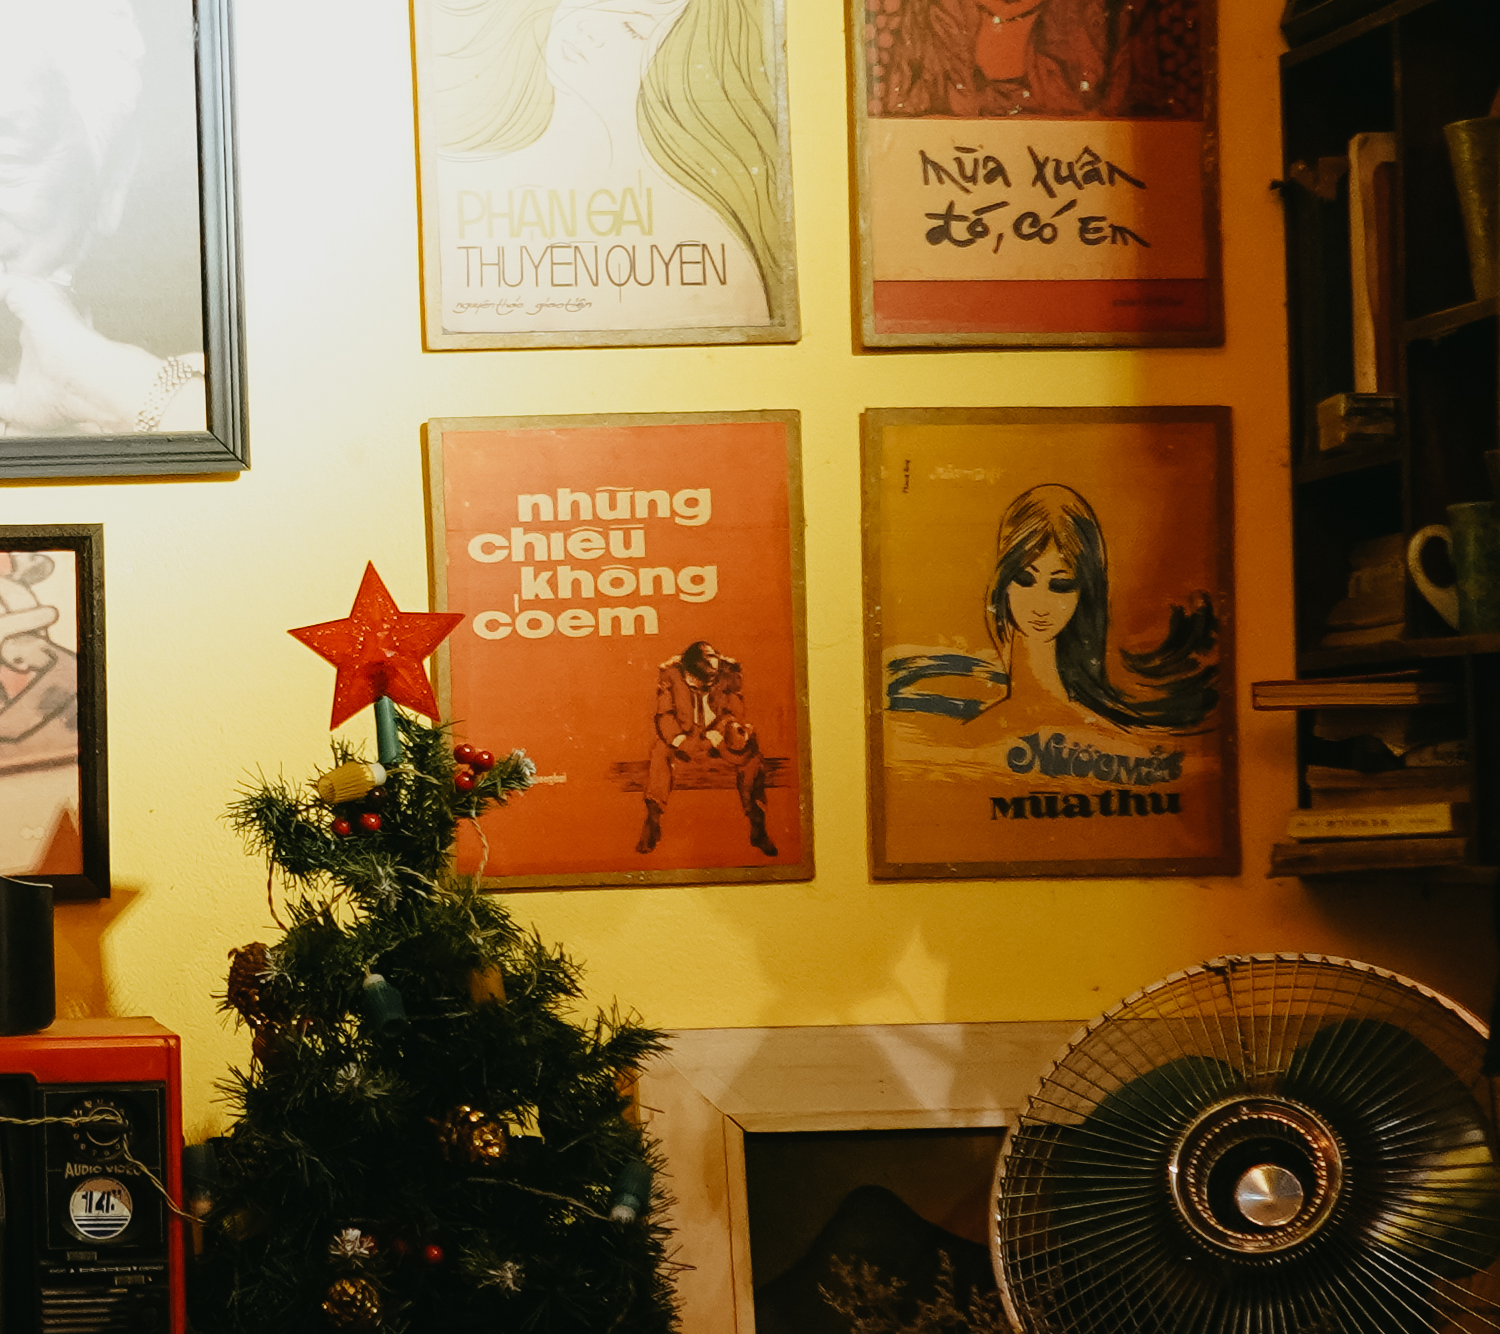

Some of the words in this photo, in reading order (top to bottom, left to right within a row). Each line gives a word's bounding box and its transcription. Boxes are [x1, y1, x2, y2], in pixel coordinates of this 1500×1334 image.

[586, 169, 654, 237] GÁI
[605, 239, 727, 303] QUYÊN
[520, 563, 719, 604] không
[64, 1161, 102, 1180] AUDIO
